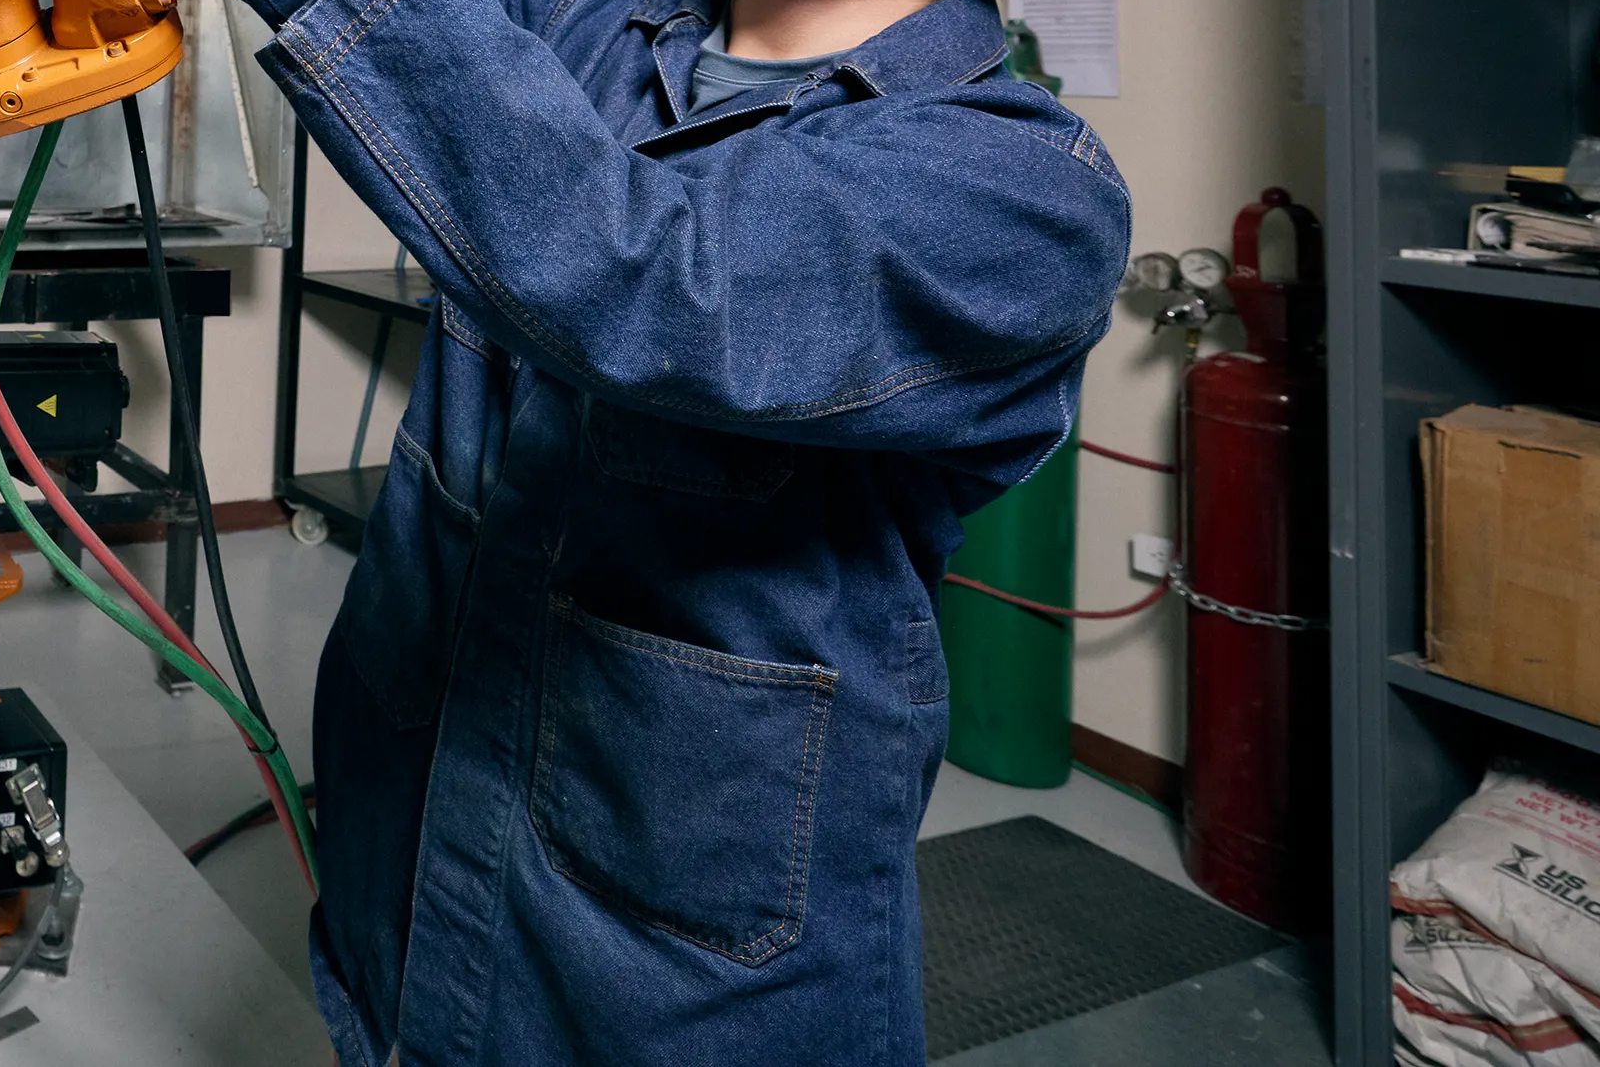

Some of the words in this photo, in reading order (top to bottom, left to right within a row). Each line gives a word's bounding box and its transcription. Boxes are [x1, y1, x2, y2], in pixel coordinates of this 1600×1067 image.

[1515, 797, 1552, 814] NET
[1529, 791, 1568, 810] NET
[1543, 864, 1588, 890] US
